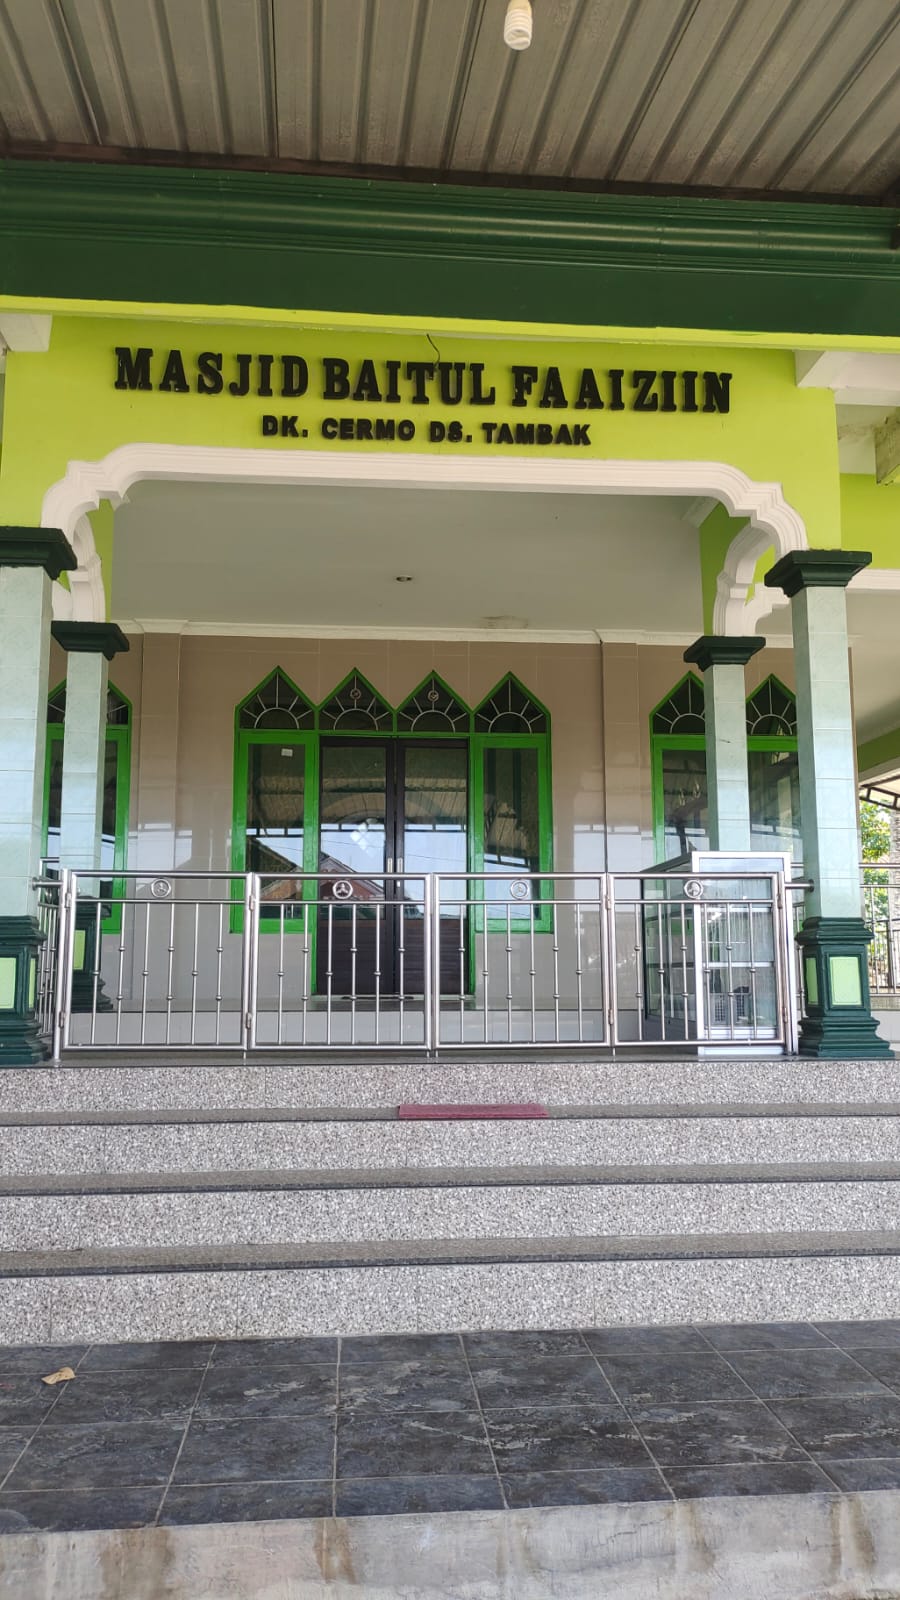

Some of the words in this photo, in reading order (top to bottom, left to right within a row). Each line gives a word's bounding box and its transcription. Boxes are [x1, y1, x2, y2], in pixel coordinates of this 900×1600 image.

[114, 346, 309, 398] MASJID
[321, 357, 496, 406] BAITUL
[510, 365, 733, 414] FAAIZIIN
[262, 414, 309, 438] DK.
[321, 417, 416, 442] CERMO
[428, 420, 473, 443] DS.
[481, 422, 591, 446] TAMBAK
